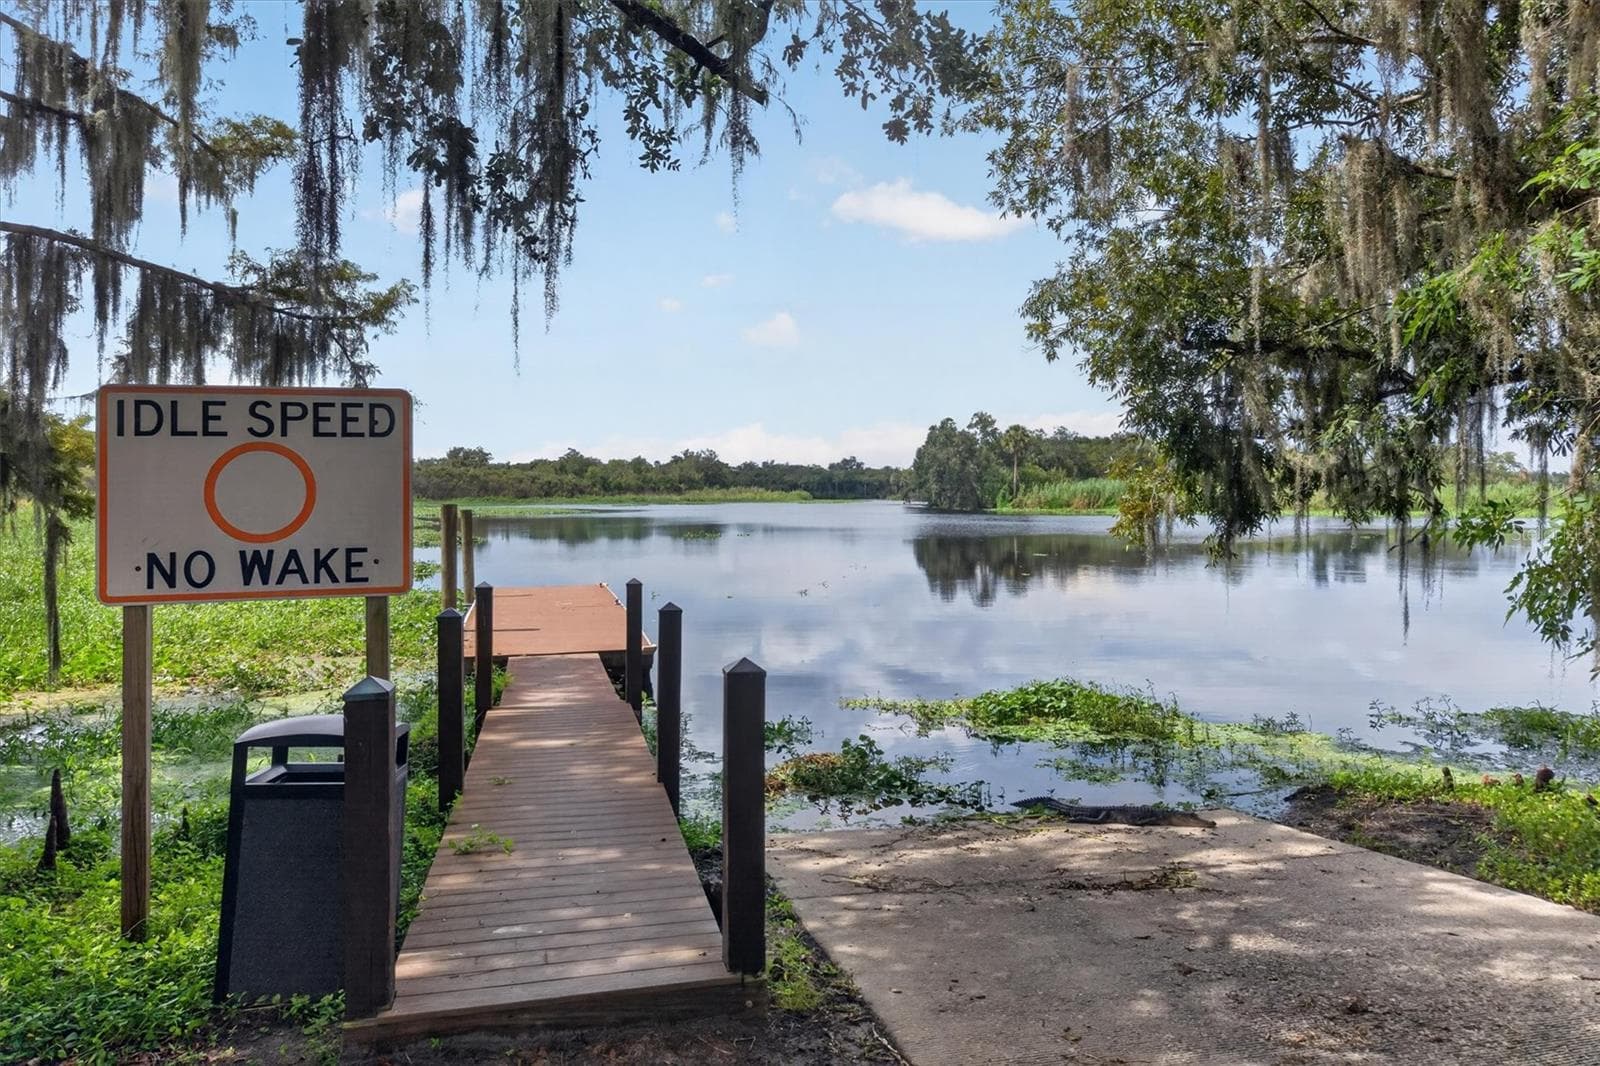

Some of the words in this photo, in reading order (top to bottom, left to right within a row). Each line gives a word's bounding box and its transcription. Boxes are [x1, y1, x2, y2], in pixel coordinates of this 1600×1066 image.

[116, 399, 228, 437] IDLE
[247, 400, 396, 438] SPEED
[146, 550, 216, 589] NO
[239, 547, 370, 586] WAKE
